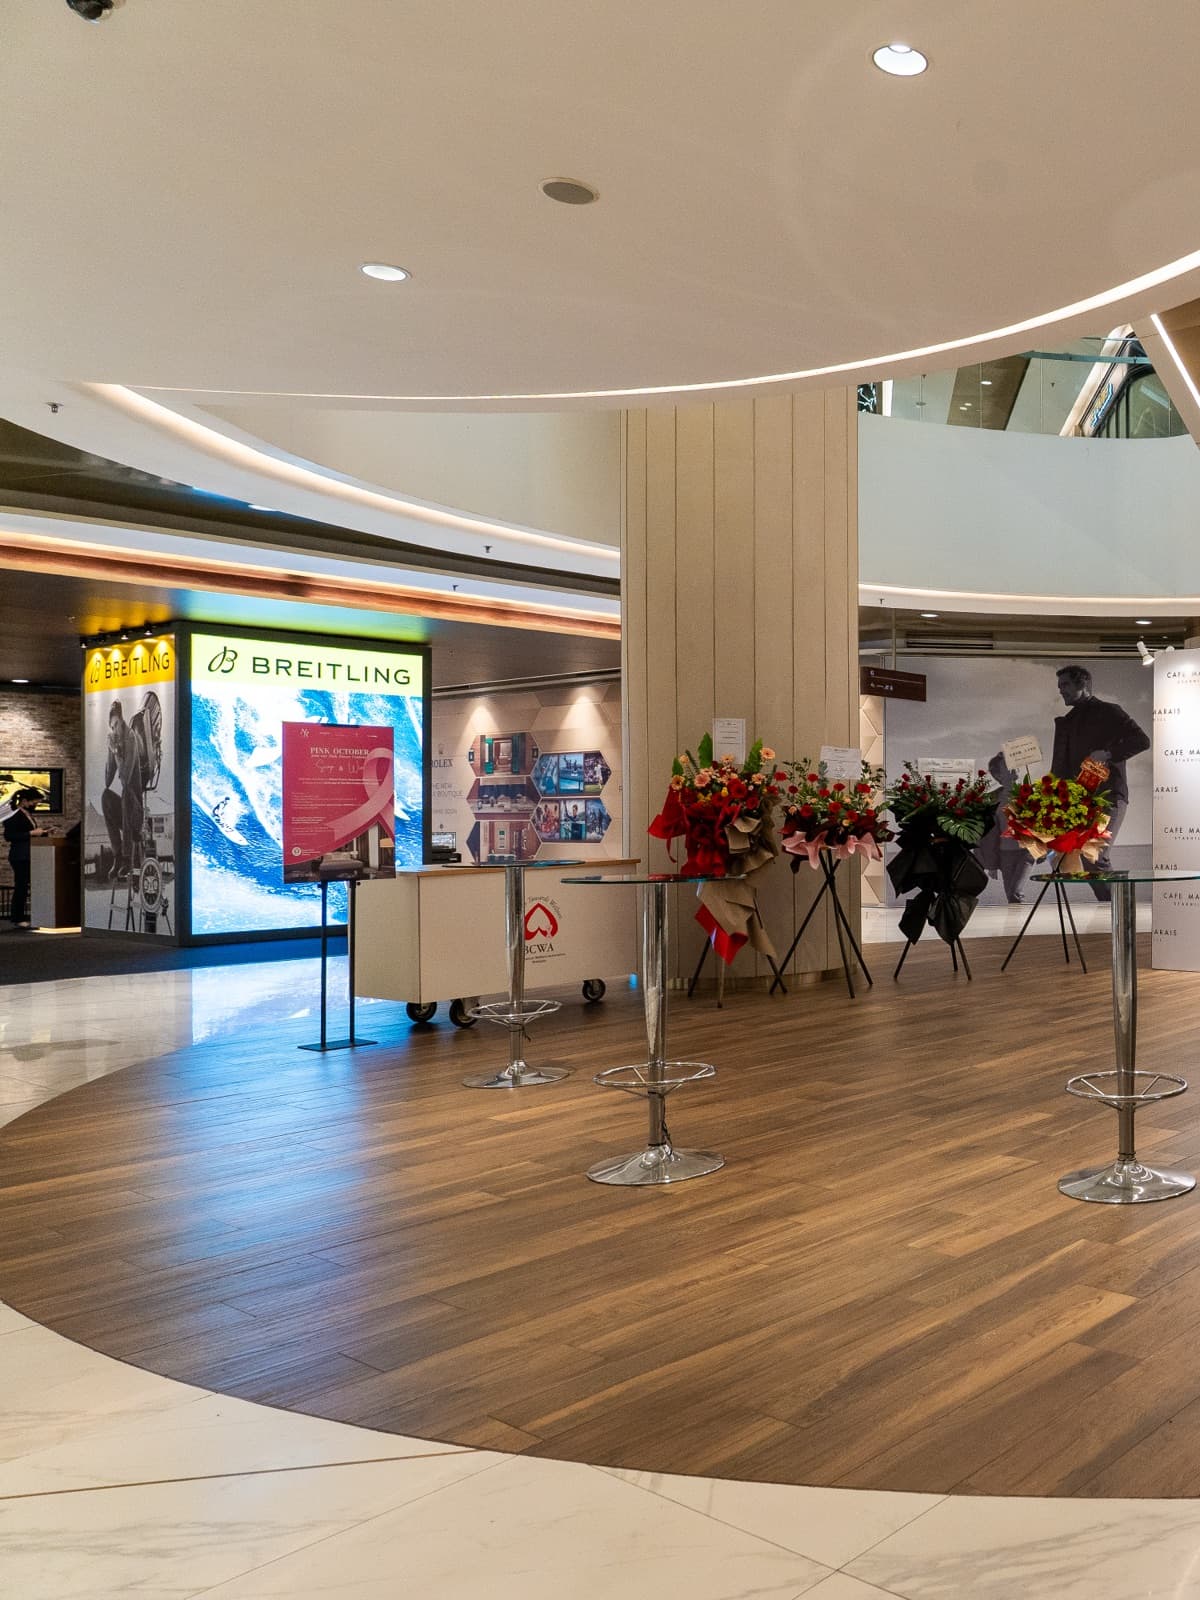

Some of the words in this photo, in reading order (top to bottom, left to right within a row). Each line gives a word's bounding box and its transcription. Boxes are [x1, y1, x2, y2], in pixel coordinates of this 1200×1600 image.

[104, 652, 170, 679] BREITLING
[252, 656, 412, 686] BREITLING
[333, 748, 369, 756] OCTOBER
[1164, 749, 1183, 757] CAFE
[1163, 892, 1183, 900] CAFE
